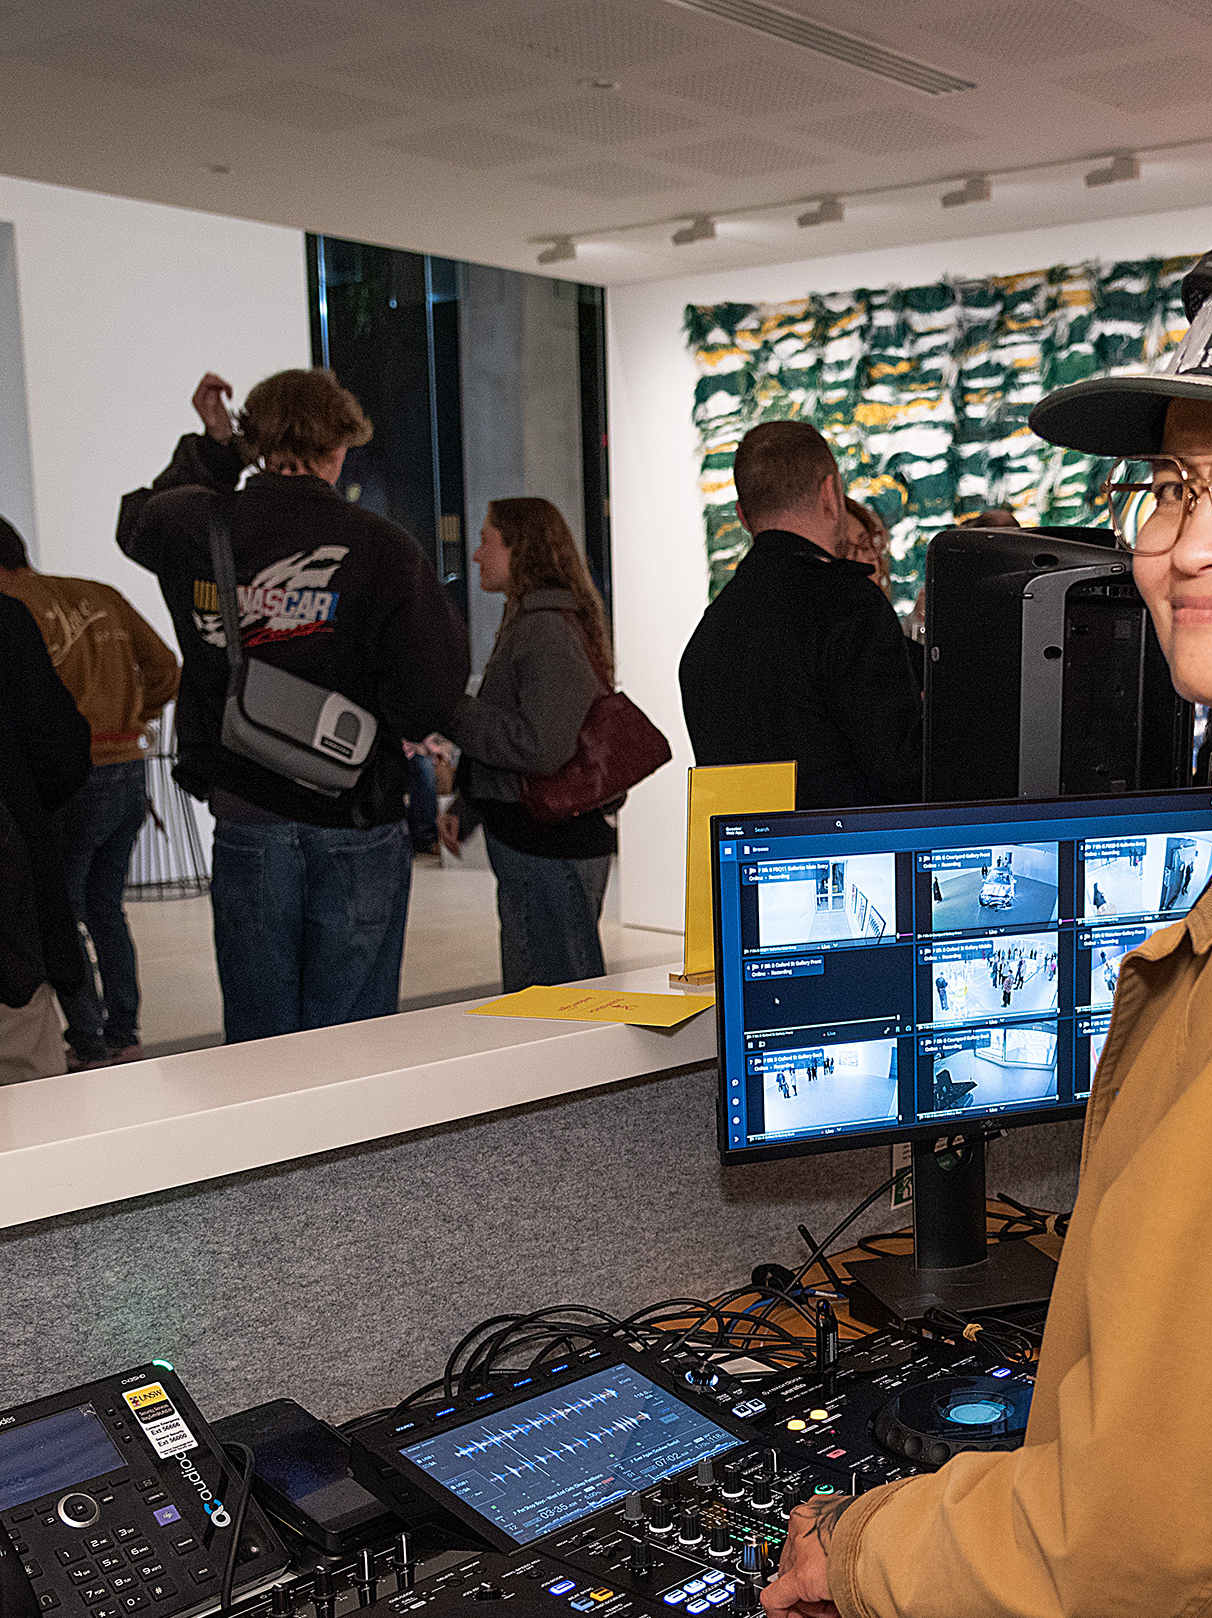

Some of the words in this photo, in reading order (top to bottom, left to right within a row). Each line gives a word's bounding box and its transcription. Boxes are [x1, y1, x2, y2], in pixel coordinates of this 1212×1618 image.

[237, 585, 333, 622] NASCAR
[138, 1389, 162, 1402] UNSW
[151, 1428, 162, 1436] Ext
[158, 1439, 169, 1447] Ext
[540, 1503, 568, 1520] 03:35
[118, 1528, 128, 1537] 3
[90, 1540, 99, 1548] 2
[131, 1548, 139, 1556] 6
[102, 1559, 111, 1567] 5
[73, 1569, 82, 1577] 4
[142, 1567, 151, 1575] 9
[114, 1578, 124, 1586] 8
[86, 1590, 94, 1598] 7
[126, 1598, 136, 1607] 0
